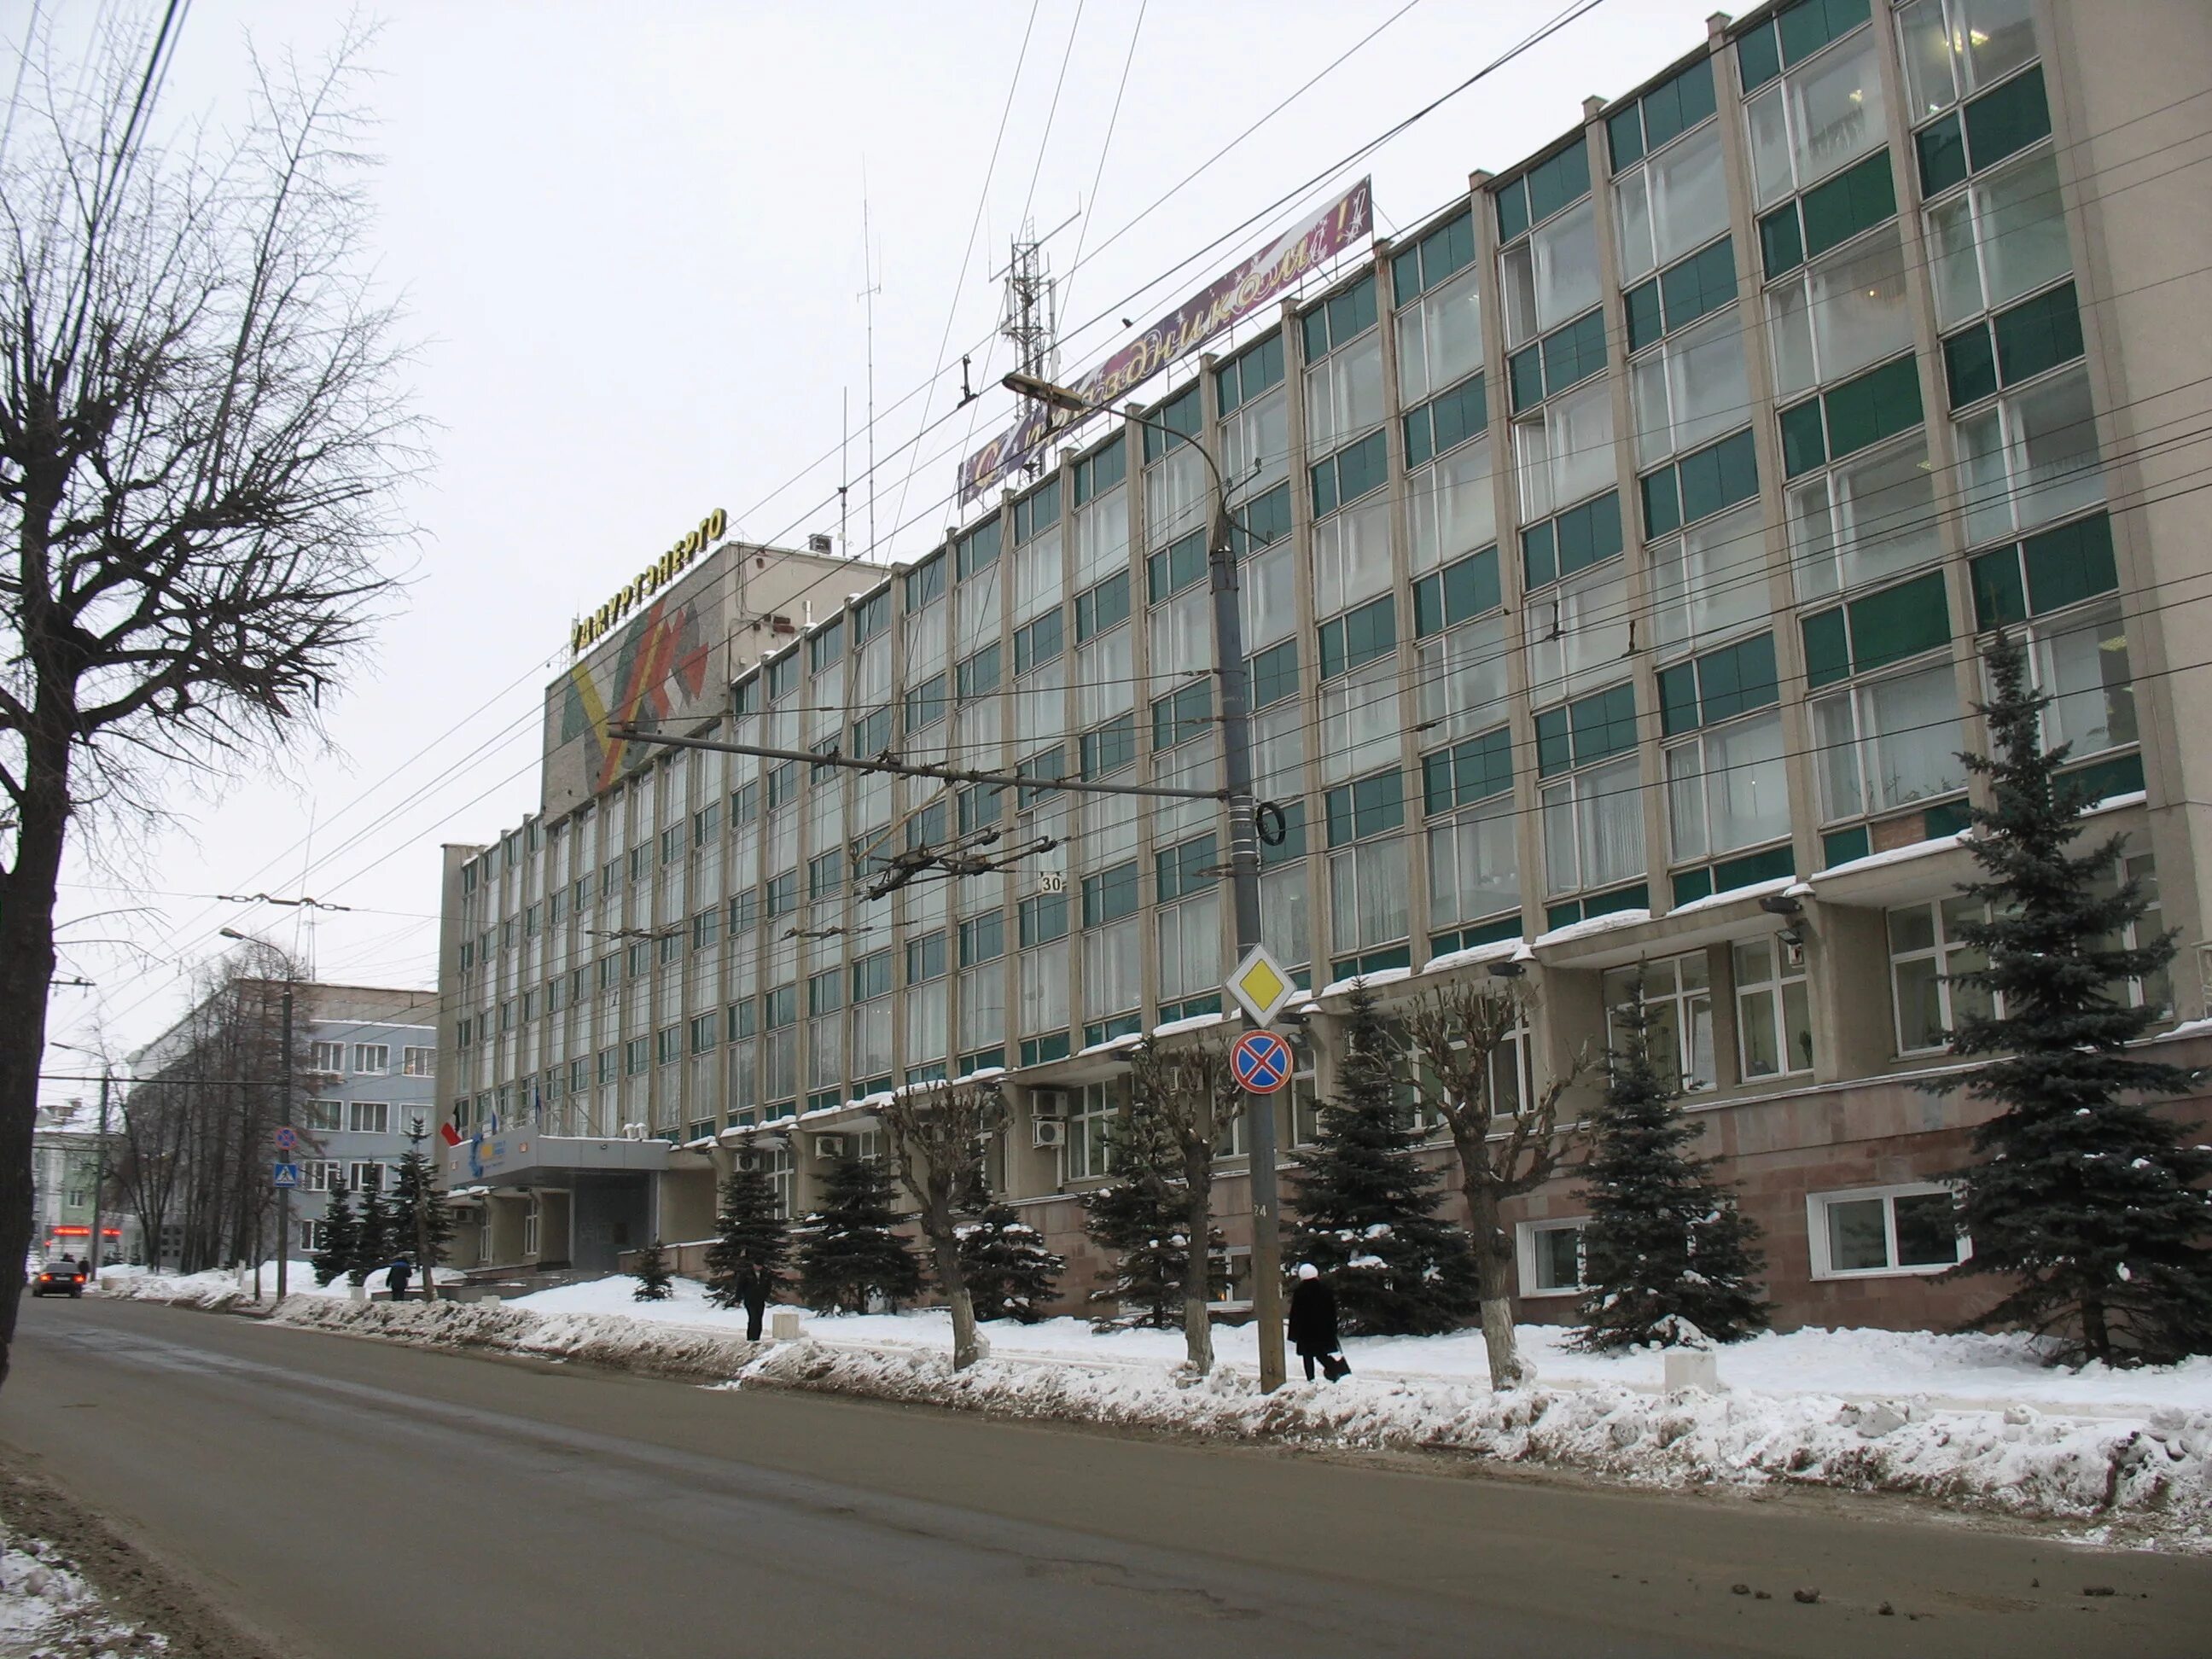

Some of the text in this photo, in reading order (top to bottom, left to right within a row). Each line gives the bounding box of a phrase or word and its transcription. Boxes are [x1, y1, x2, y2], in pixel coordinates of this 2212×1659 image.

[975, 439, 999, 488] С
[571, 508, 727, 654] УДМУРТЭНЕРГО
[1042, 877, 1061, 891] 30
